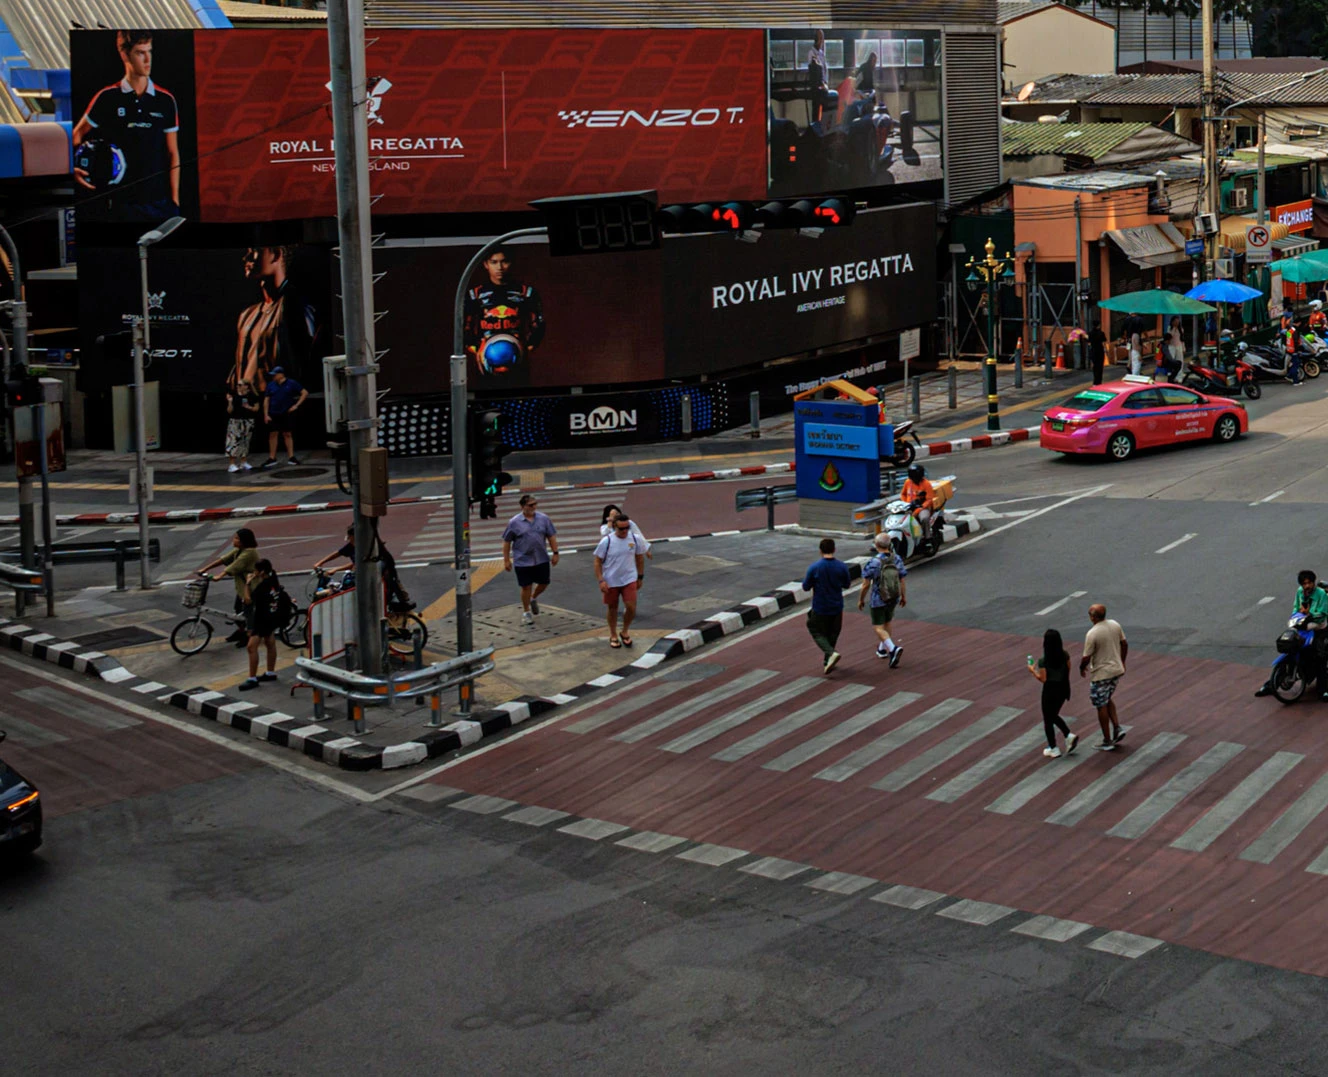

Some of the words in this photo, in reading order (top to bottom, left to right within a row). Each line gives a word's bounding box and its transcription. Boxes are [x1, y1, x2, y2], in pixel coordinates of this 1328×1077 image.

[585, 108, 721, 128] ENZO
[726, 107, 744, 124] T.
[270, 139, 324, 155] ROYAL
[370, 137, 464, 151] REGATTA
[1278, 207, 1313, 227] EXCHANGE
[712, 276, 786, 309] ROYAL
[792, 268, 824, 293] IVY
[829, 253, 914, 287] REGATTA
[569, 406, 637, 430] BMN
